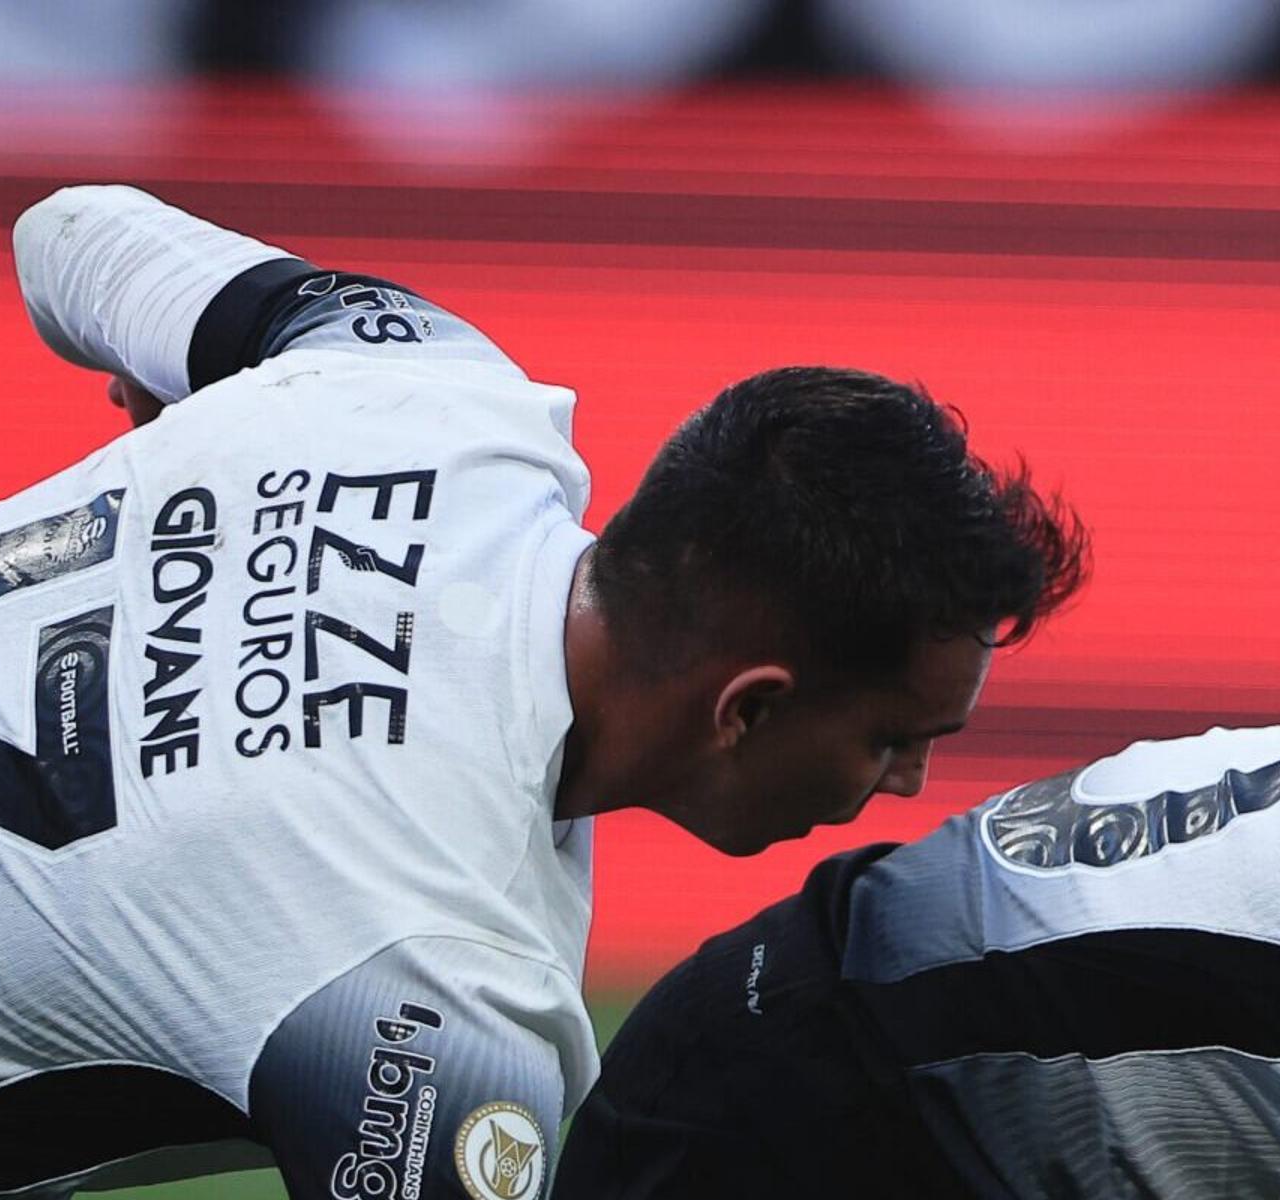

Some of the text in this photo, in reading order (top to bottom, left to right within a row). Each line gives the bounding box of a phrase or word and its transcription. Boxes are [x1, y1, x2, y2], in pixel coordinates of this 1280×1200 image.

[139, 486, 218, 780] GIOVANE
[234, 468, 311, 759] SEGUROS
[303, 467, 439, 750] EZZE
